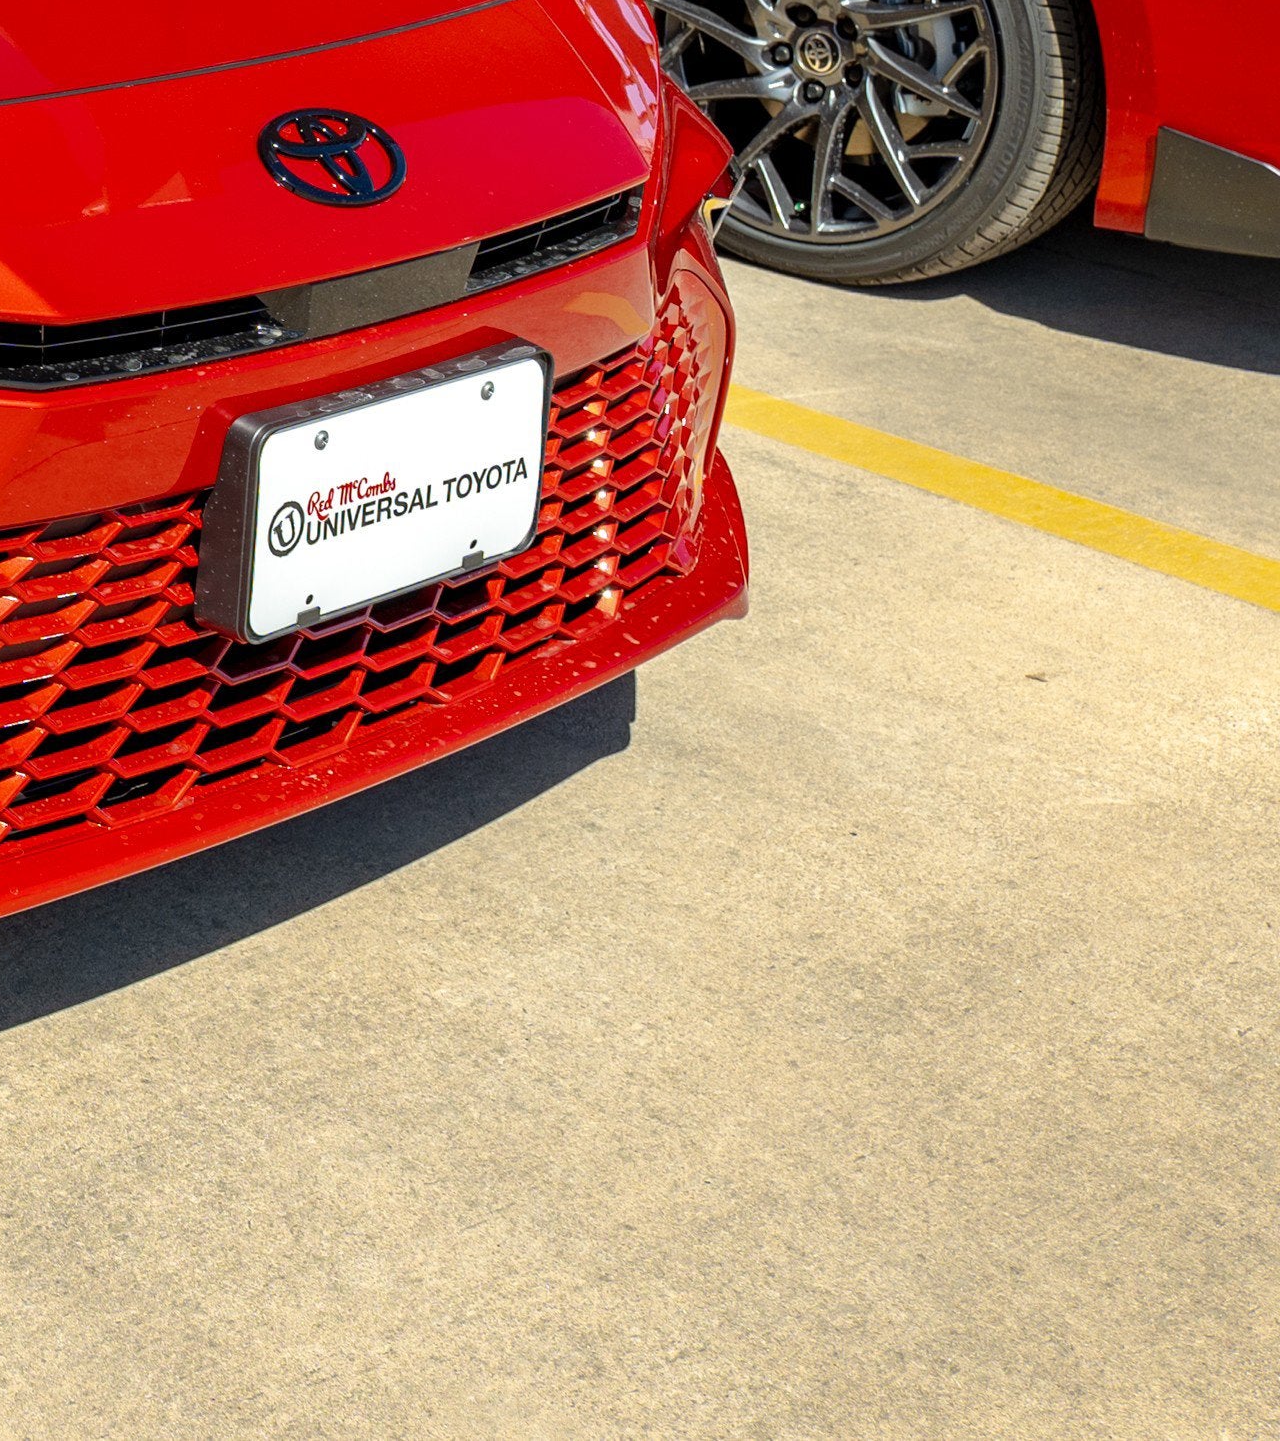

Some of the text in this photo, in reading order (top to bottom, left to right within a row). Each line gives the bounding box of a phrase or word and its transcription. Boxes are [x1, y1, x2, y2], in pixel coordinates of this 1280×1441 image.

[306, 457, 528, 546] UNIVERSAL TOYOTA
[307, 471, 396, 521] Red McCombs
